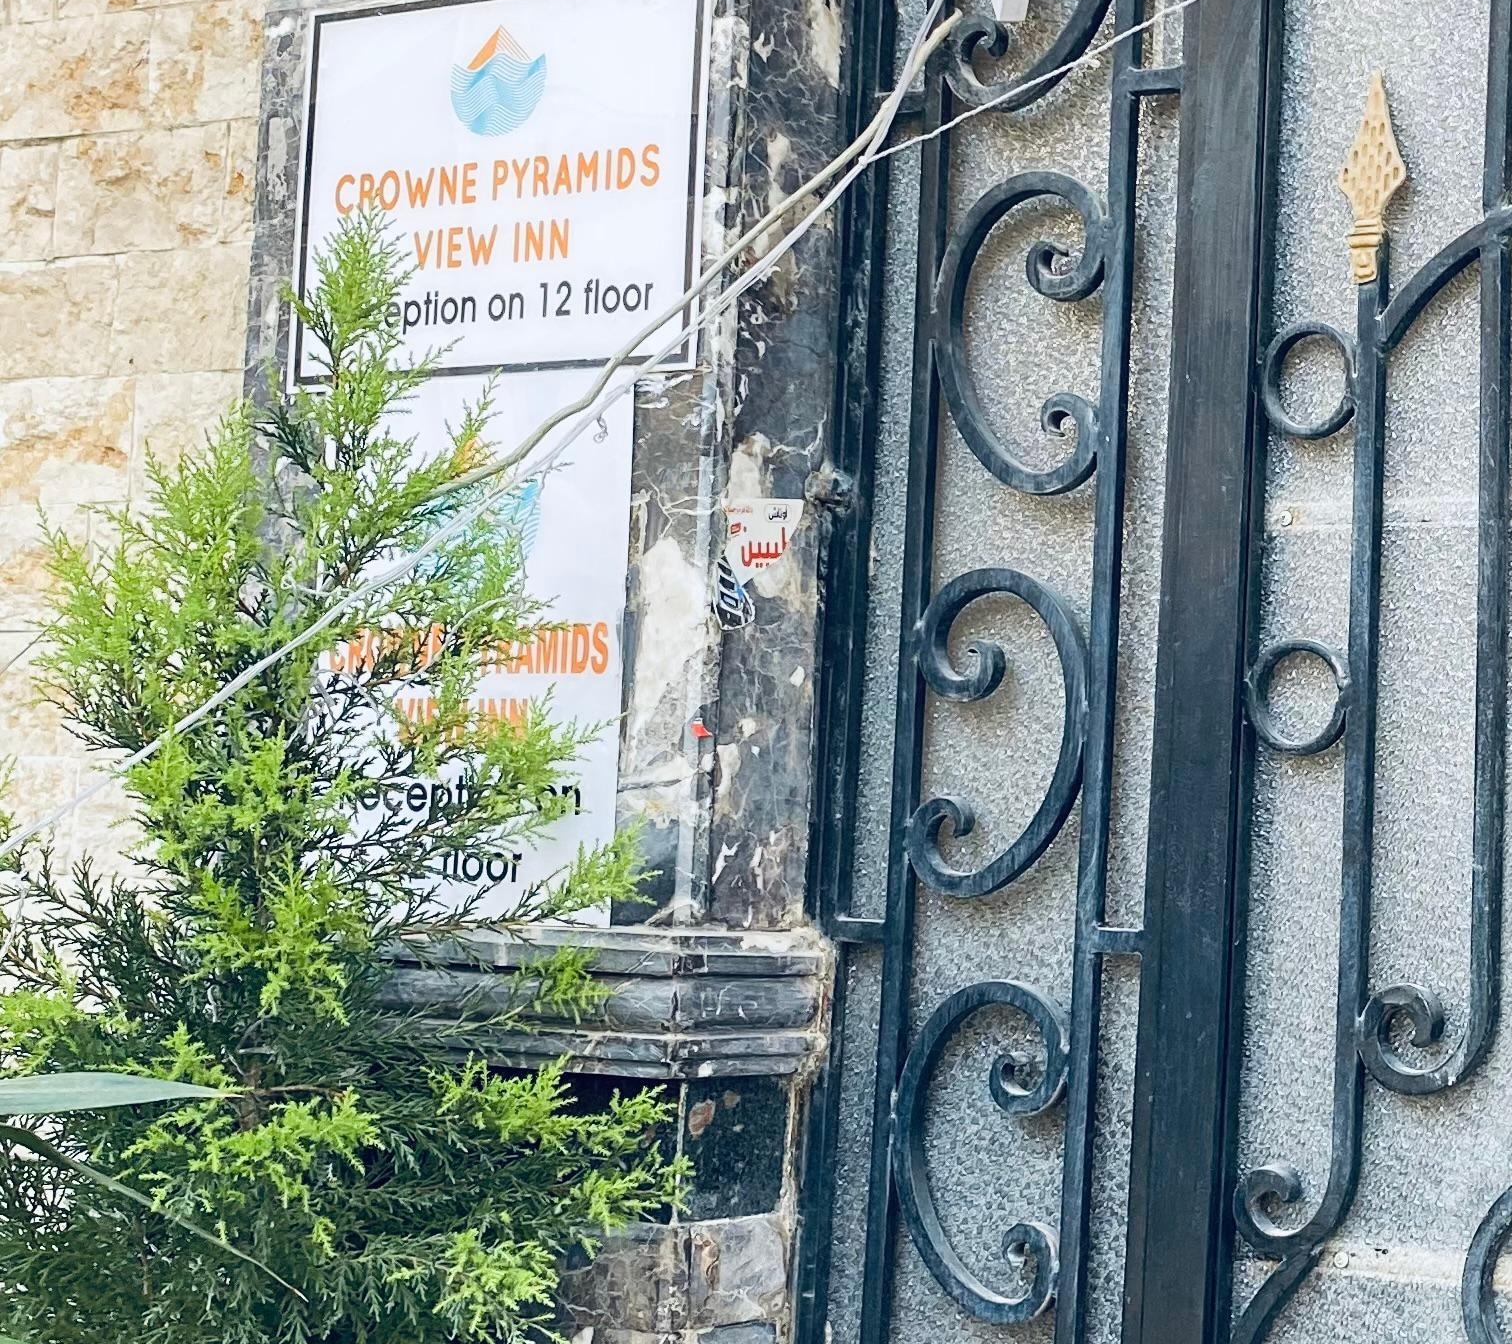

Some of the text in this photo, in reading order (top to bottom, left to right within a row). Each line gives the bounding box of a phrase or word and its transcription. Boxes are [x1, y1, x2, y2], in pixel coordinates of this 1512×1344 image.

[335, 143, 662, 215] CROWNE PYRAMIDS
[414, 218, 570, 271] VIEW INN
[384, 278, 654, 335] eption on 12 floor
